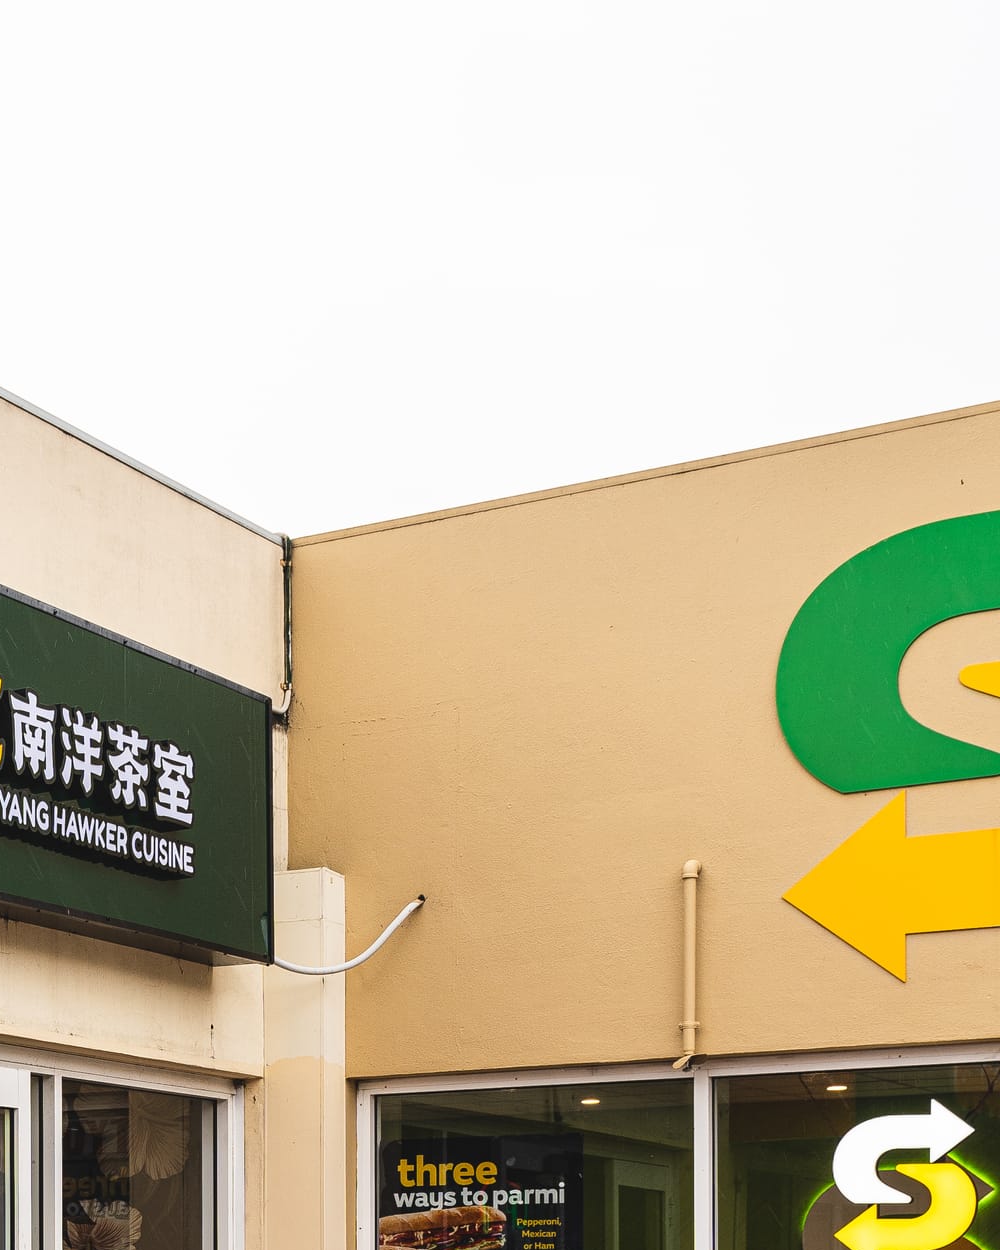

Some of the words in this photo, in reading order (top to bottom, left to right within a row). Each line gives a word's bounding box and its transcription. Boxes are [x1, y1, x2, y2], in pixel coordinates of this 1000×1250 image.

[10, 691, 194, 825] 南洋茶室
[53, 805, 128, 856] HAWKER
[131, 831, 195, 874] CUISINE
[397, 1154, 498, 1188] three
[393, 1190, 456, 1211] ways
[460, 1187, 489, 1206] to
[492, 1181, 566, 1210] parmi
[516, 1217, 562, 1228] Pepperoni,
[521, 1230, 557, 1239] Mexican
[534, 1241, 555, 1250] Ham
